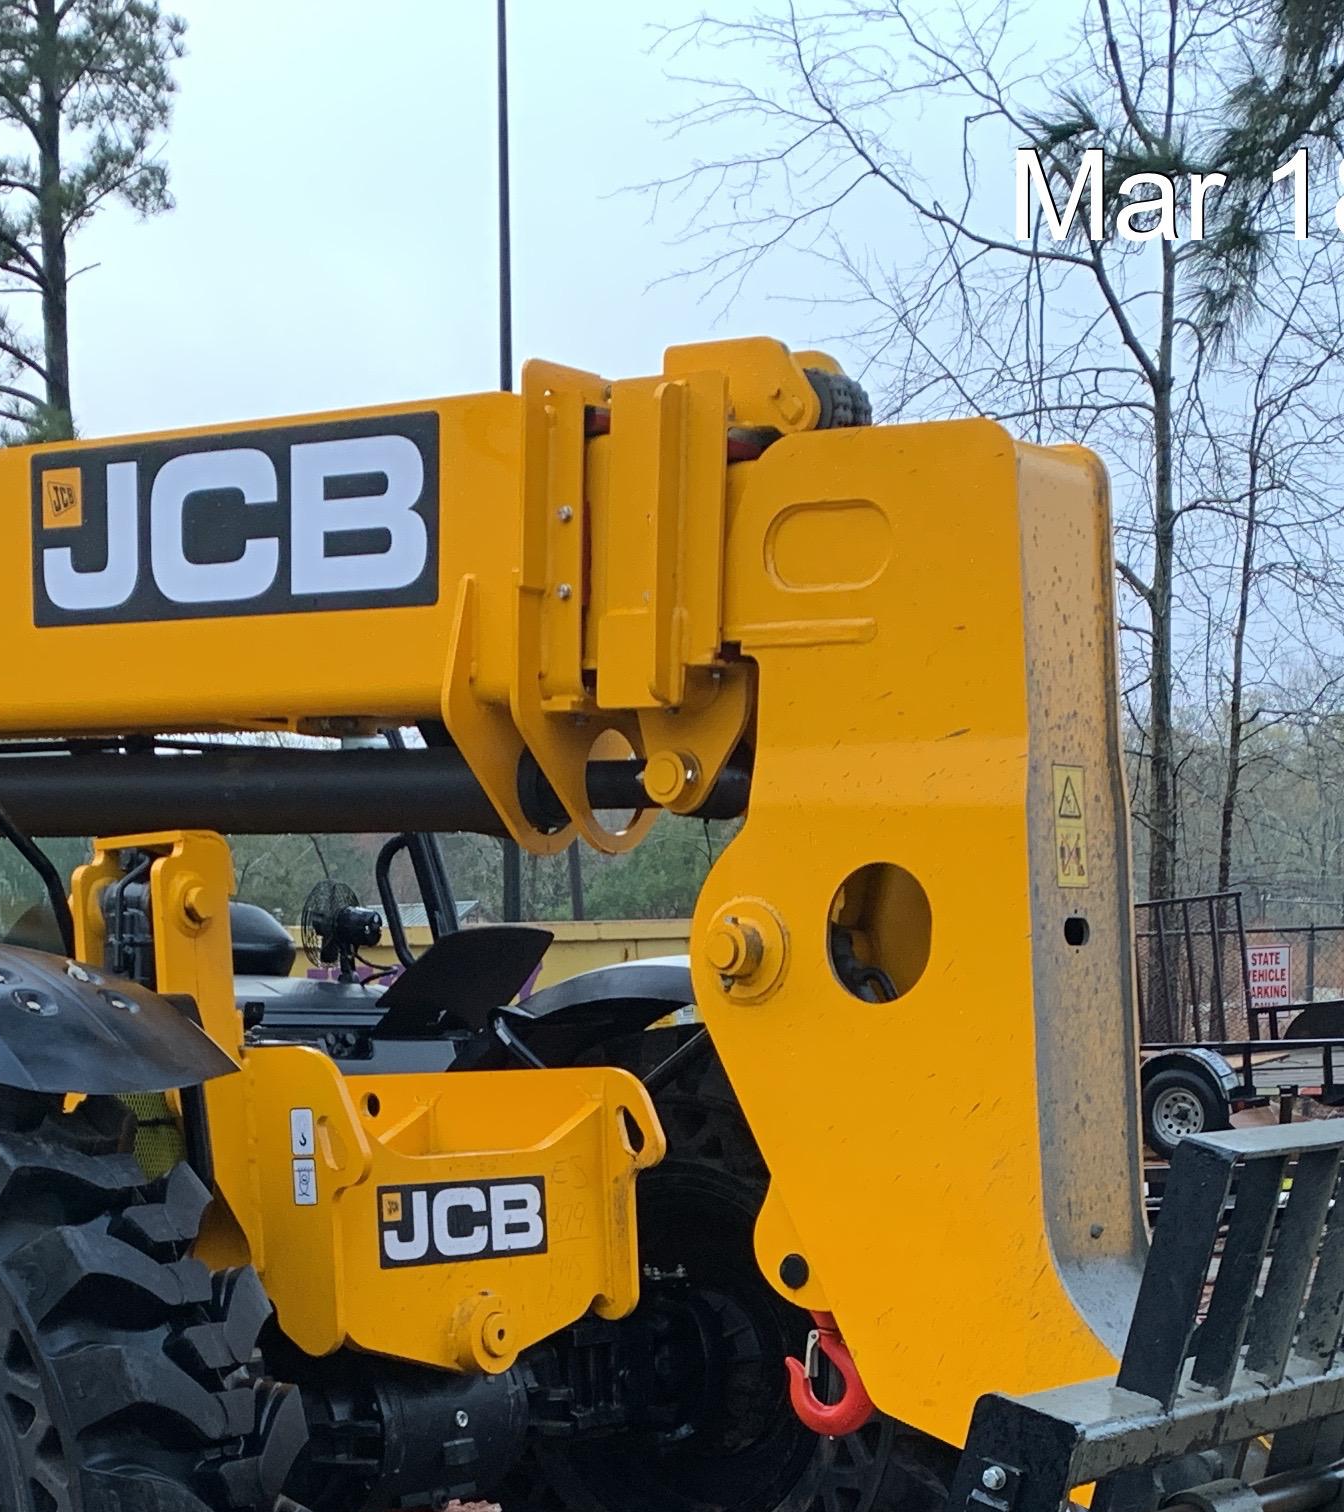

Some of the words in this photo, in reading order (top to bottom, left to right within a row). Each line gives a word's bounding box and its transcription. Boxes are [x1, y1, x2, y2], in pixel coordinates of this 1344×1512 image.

[43, 434, 428, 611] JCB
[1251, 951, 1281, 967] STATE
[1250, 985, 1287, 998] ARKING
[383, 1183, 544, 1261] JCB
